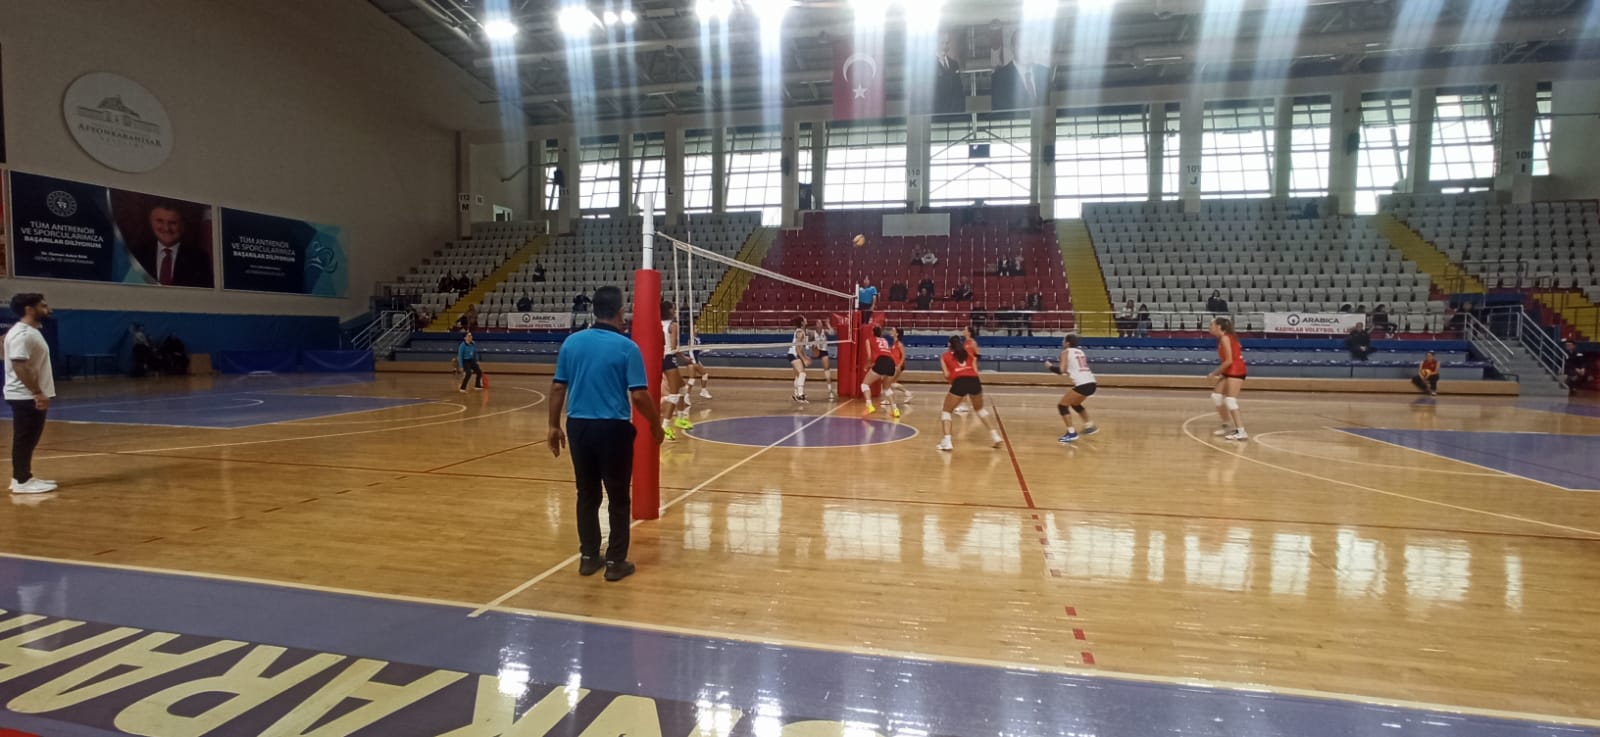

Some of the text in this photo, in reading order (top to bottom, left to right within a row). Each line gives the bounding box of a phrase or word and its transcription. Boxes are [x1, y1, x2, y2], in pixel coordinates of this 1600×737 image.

[909, 179, 917, 188] K
[20, 227, 32, 236] VE
[30, 220, 95, 235] TÜM ANTRENÖR
